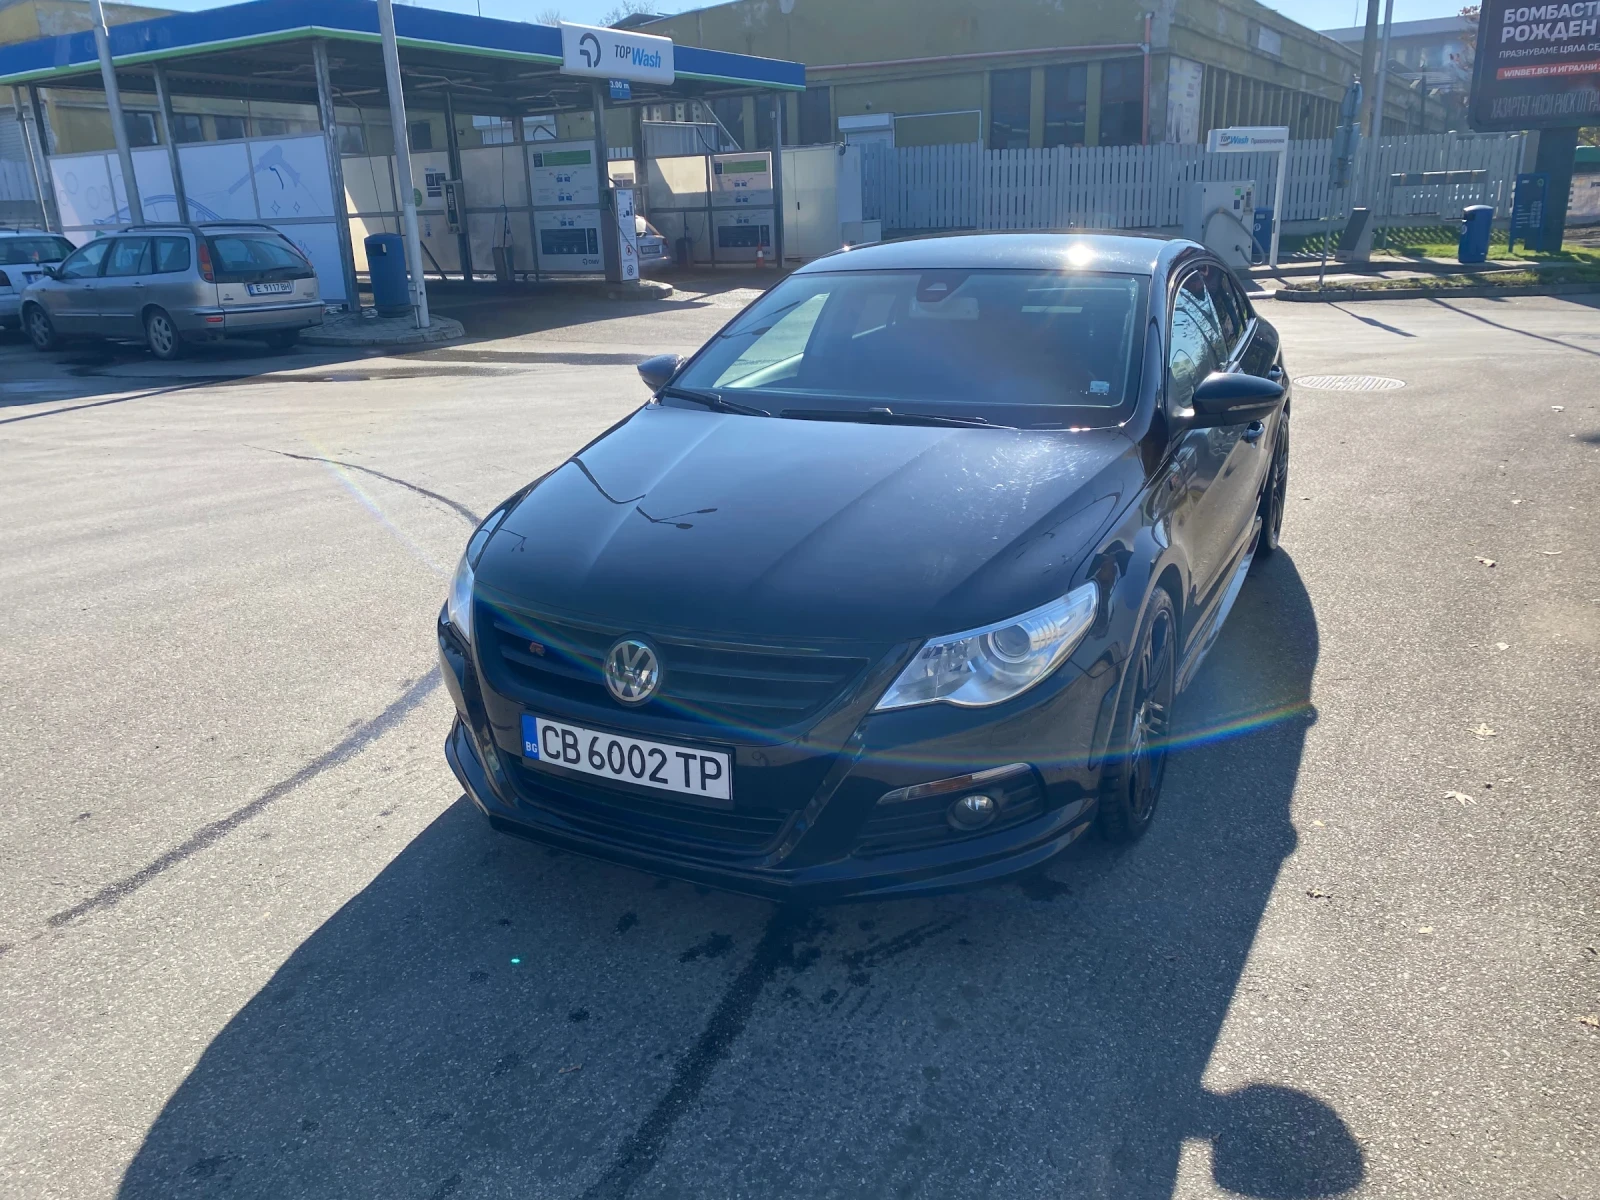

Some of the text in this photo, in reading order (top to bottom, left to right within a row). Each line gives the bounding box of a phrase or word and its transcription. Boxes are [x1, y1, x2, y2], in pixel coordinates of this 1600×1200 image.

[1501, 19, 1597, 43] РОЖДЕН
[614, 44, 661, 68] TOP Wash
[1499, 42, 1600, 58] ПРАЗНУВАМЕ ЦЯЛА СЕ
[1504, 66, 1549, 77] WINBET.BG
[1550, 66, 1556, 74] И
[1557, 63, 1598, 73] ИГРАЛНИ
[610, 80, 623, 89] 3.00
[1554, 91, 1577, 115] РИСК
[1230, 135, 1249, 145] Wash
[256, 284, 262, 292] E
[525, 741, 538, 753] BG
[541, 725, 722, 791] CB 6002 TP
